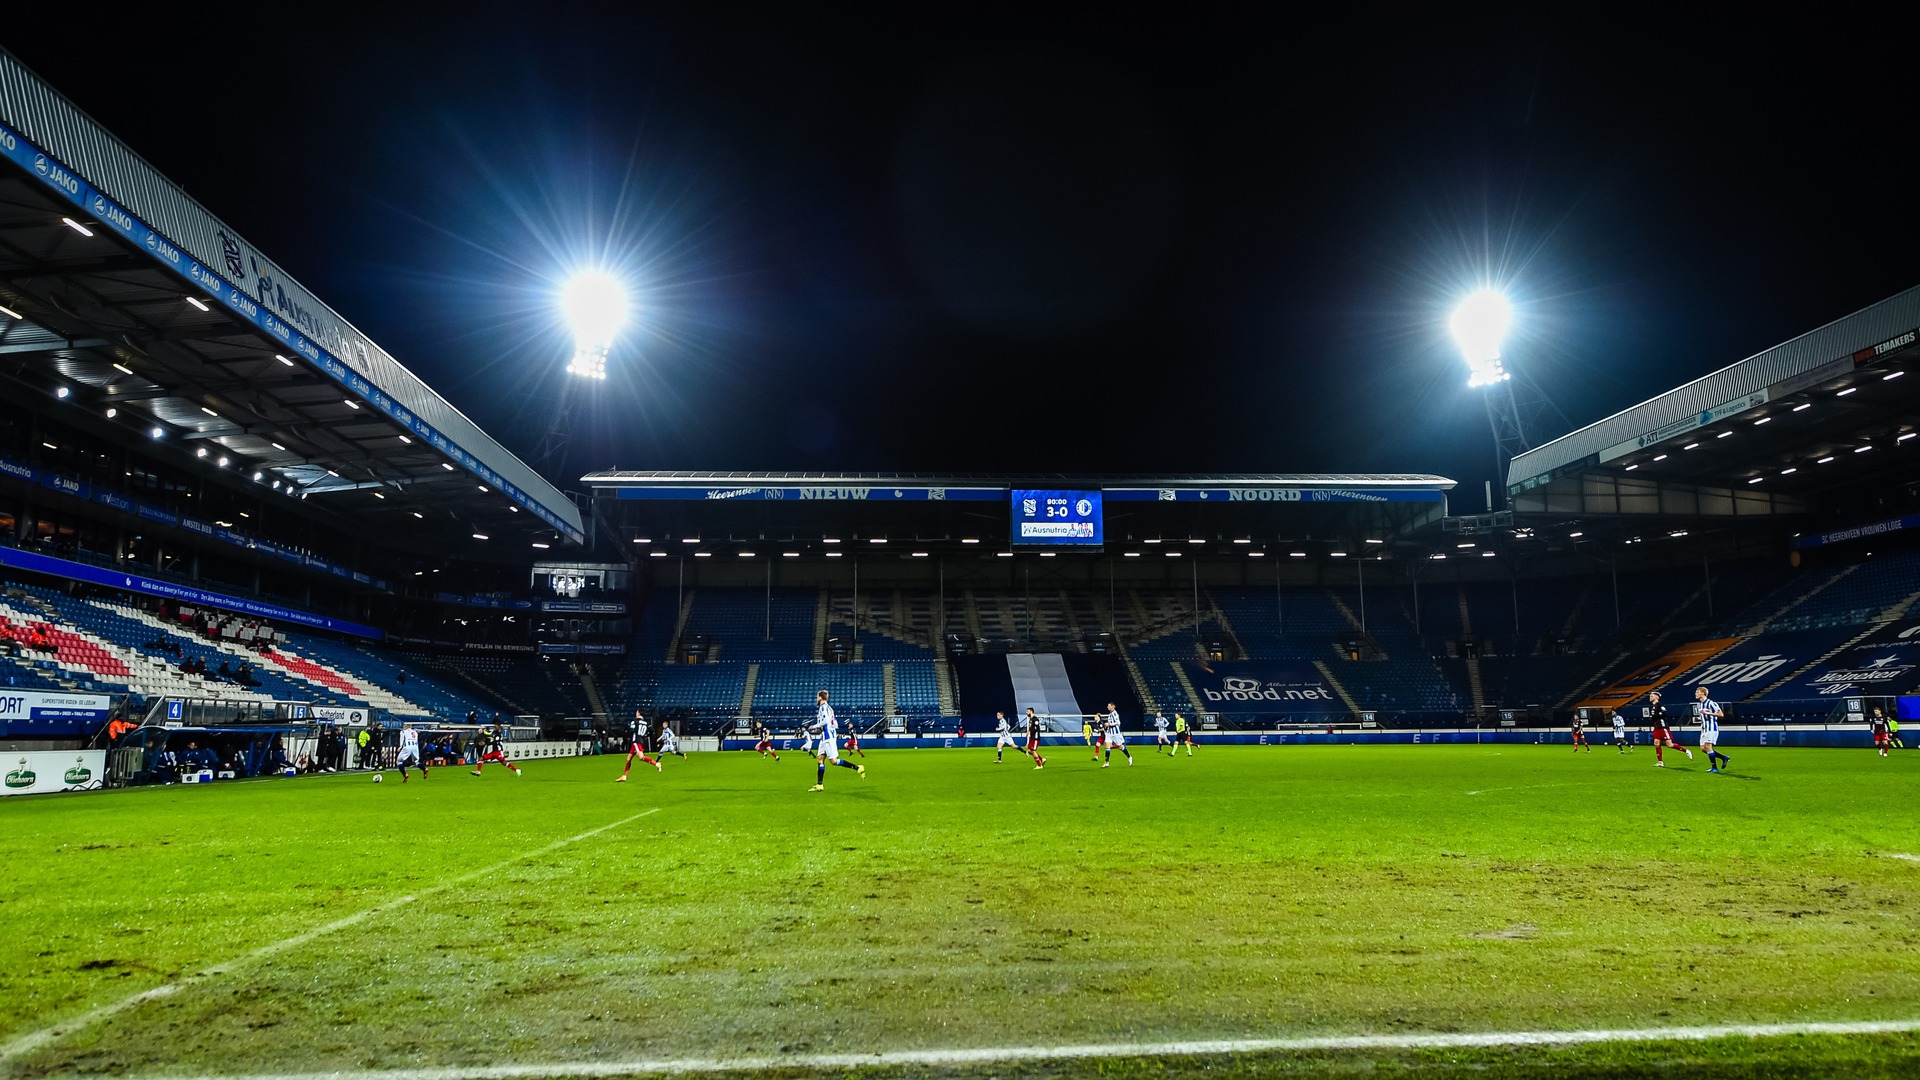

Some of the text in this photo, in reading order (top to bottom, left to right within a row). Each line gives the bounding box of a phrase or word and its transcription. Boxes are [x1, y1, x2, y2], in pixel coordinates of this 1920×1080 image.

[0, 128, 16, 151] KO
[50, 166, 78, 194] JAKO
[107, 206, 132, 231] JAKO
[157, 240, 179, 264] JAKO
[200, 270, 220, 292] JAKO
[239, 299, 257, 317] JAKO
[274, 321, 290, 340] JAKO
[304, 342, 319, 360] JAKO
[332, 362, 346, 378] JAKO
[1646, 432, 1658, 444] ATI
[0, 460, 31, 478] Ausnutria
[62, 478, 79, 492] JAKO
[800, 488, 870, 499] NIEUW
[1229, 490, 1301, 500] NOORD
[1047, 507, 1068, 517] 3-0
[182, 518, 201, 530] AMSTEL
[202, 524, 212, 534] BIER
[1830, 529, 1860, 542] HEERENVEEN
[1861, 524, 1886, 536] VROUWEN
[1888, 520, 1902, 530] LOGE
[1683, 654, 1788, 686] TOTO
[1815, 668, 1902, 682] Heineken
[1204, 687, 1332, 700] brood.net
[0, 696, 24, 713] ORT
[172, 703, 178, 716] 4
[1850, 701, 1859, 710] 18
[298, 707, 304, 717] 5
[320, 709, 345, 720] Sutherland
[638, 724, 647, 736] 10
[945, 739, 952, 748] E
[1260, 736, 1287, 744] E F
[1413, 734, 1440, 743] E F
[1539, 733, 1543, 742] E
[1760, 732, 1786, 745] E F
[783, 740, 791, 749] E
